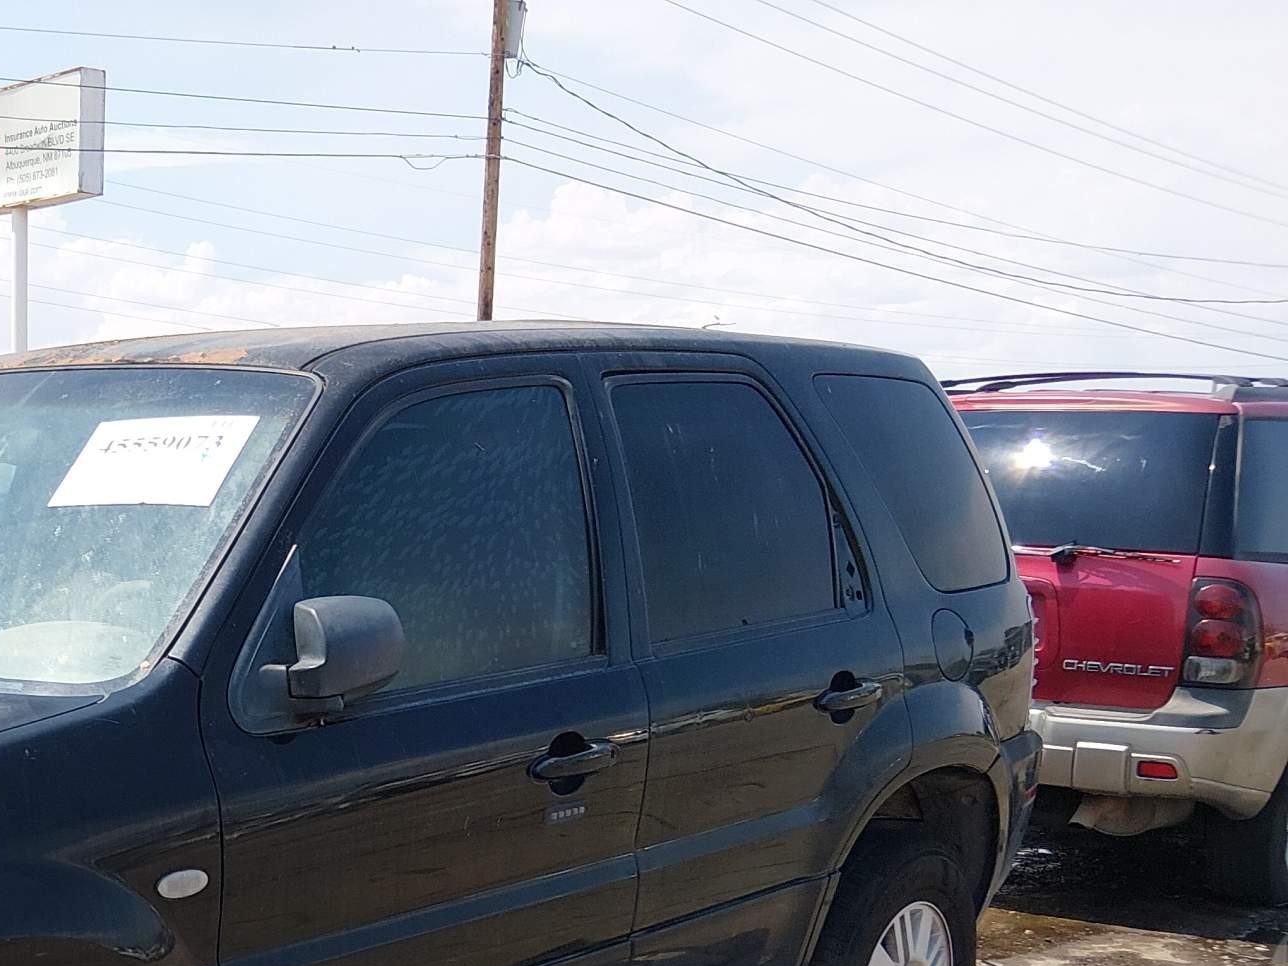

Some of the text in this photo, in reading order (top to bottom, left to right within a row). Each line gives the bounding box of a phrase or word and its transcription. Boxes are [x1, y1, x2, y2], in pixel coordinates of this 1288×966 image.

[4, 129, 33, 144] Insurance
[34, 125, 48, 136] Auto
[65, 131, 76, 143] SE
[1063, 659, 1175, 678] CHEVROLET
